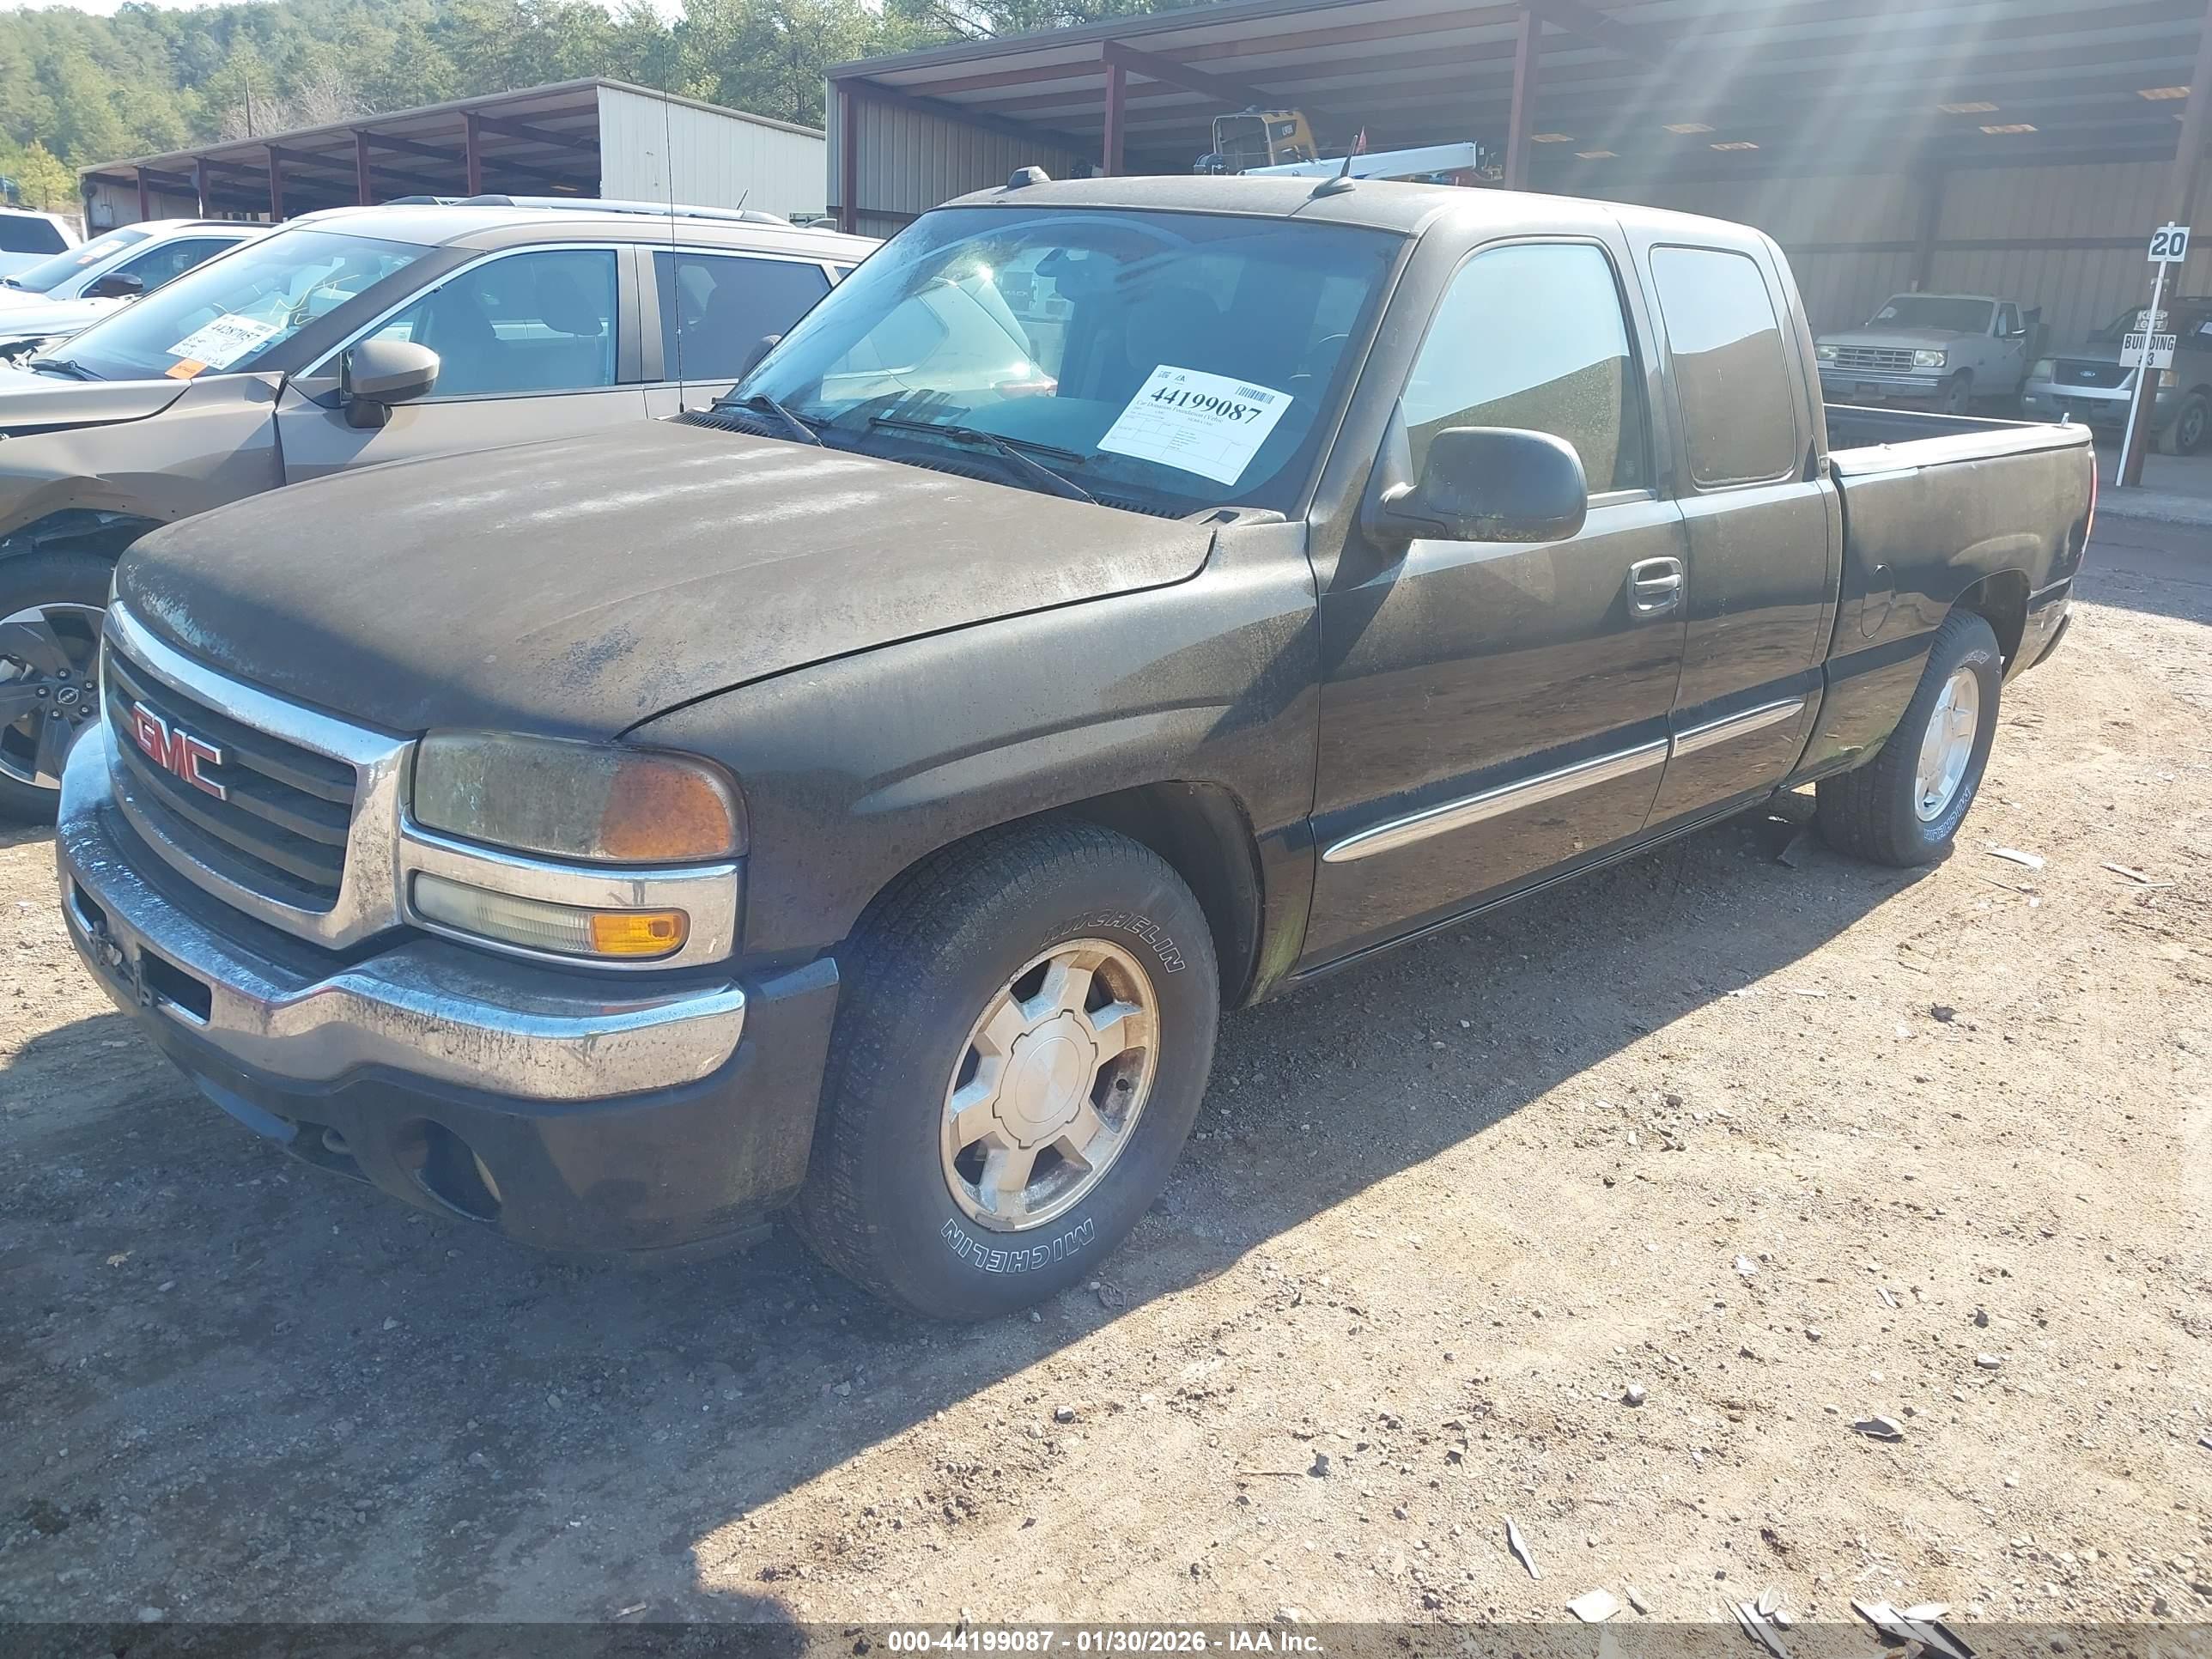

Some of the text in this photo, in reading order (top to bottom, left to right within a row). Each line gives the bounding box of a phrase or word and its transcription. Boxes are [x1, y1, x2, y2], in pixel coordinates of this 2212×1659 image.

[2151, 232, 2185, 257] 20
[2140, 319, 2163, 329] OT
[1152, 386, 1262, 424] 44199087
[132, 701, 227, 801] GMC
[940, 1217, 1096, 1273] MICHELIN
